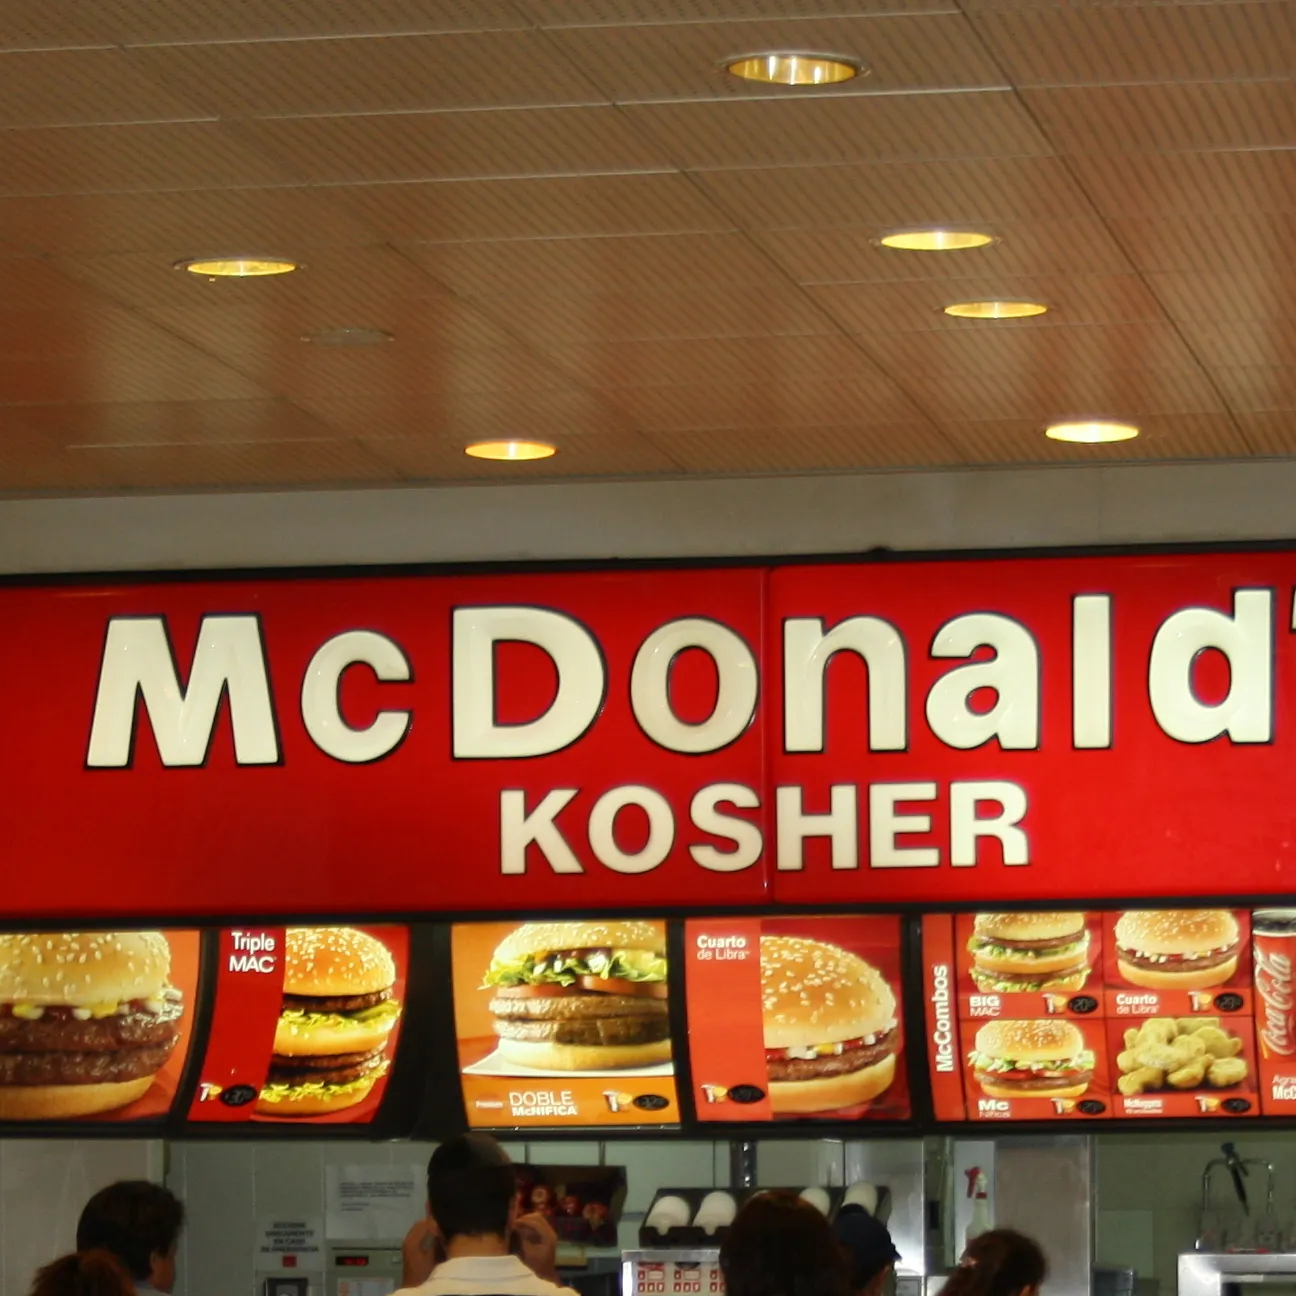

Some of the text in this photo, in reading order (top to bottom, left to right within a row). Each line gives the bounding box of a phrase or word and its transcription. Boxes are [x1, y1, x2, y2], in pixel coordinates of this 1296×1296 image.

[500, 780, 1032, 876] KOSHER
[231, 932, 275, 955] Triple
[697, 934, 746, 948] Cuarto
[697, 948, 747, 960] de Libra
[229, 956, 275, 973] MAC
[969, 996, 1000, 1007] BIG
[1116, 993, 1158, 1005] Cuarto
[931, 965, 954, 1072] McCombos
[969, 1007, 1000, 1017] MAC
[509, 1091, 574, 1107] DOBLE
[978, 1098, 1009, 1110] Mc
